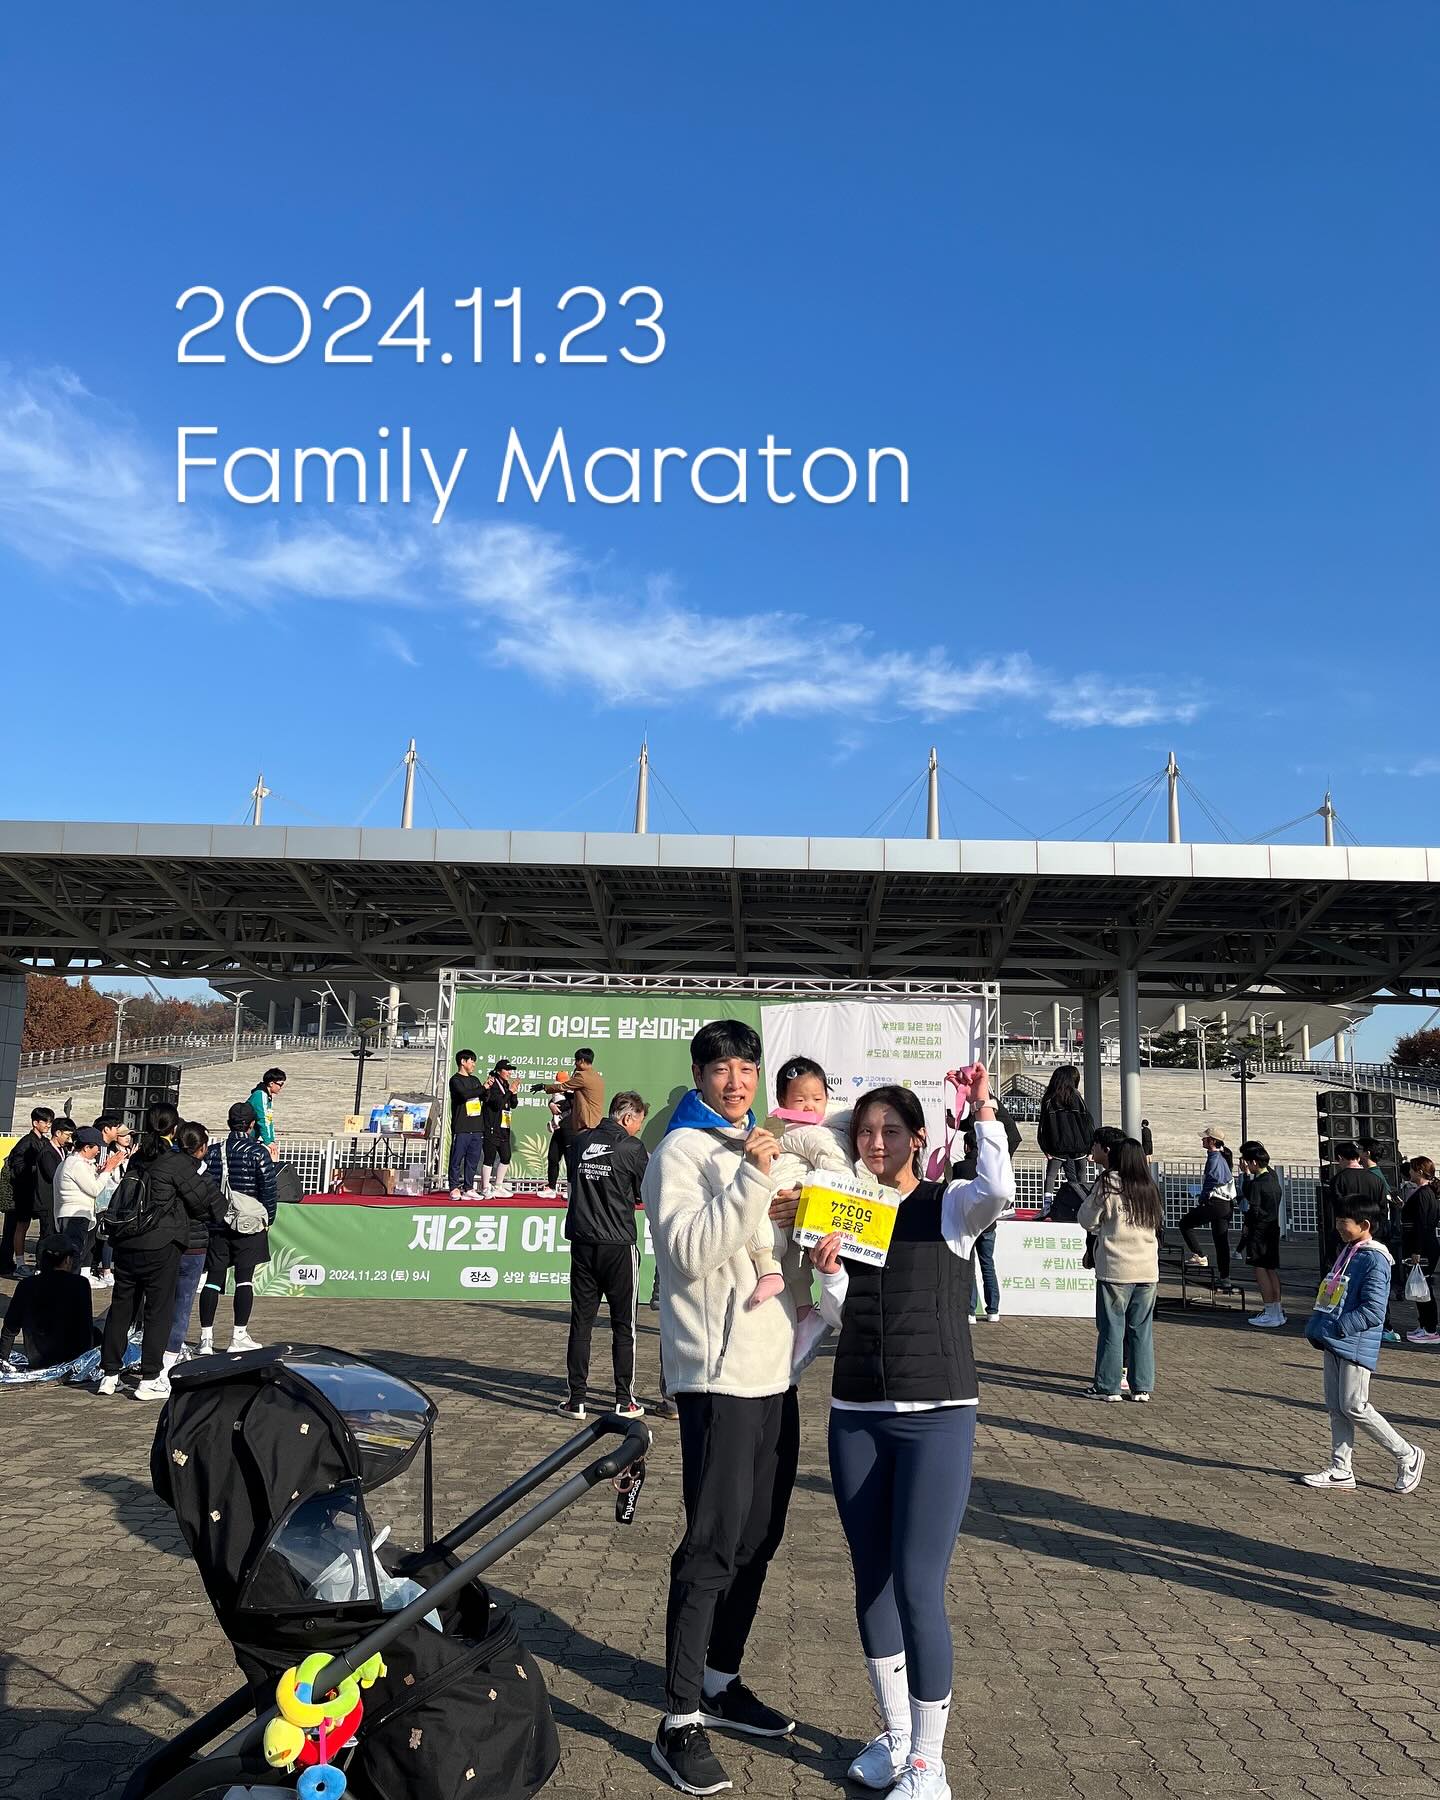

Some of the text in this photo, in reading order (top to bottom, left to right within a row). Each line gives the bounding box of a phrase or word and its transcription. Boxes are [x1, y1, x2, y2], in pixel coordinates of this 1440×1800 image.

[484, 1012, 723, 1040] 제2회 여의도 밤섬마라
[881, 1022, 942, 1032] #밤을 닮은 밤섬
[896, 1036, 942, 1045] #람사르습지
[866, 1048, 942, 1059] #도심 속 철새도래지
[511, 1055, 559, 1066] 2024.11.23
[913, 1079, 943, 1087] 이브자리
[586, 1142, 609, 1154] NIKE
[830, 1200, 873, 1222] 50344
[831, 1216, 864, 1234] 장준영
[408, 1214, 509, 1252] 제2회
[841, 1241, 863, 1254] 여의도
[1023, 1236, 1083, 1250] #밤을 닮은
[864, 1248, 884, 1260] 제2회
[298, 1268, 430, 1282] 일시 2024.11.23 (토) 9시
[469, 1271, 491, 1283] 장소
[503, 1271, 525, 1284] 상암
[1001, 1276, 1035, 1289] #도심
[1039, 1277, 1051, 1290] 속
[621, 1479, 642, 1520] dragonfly
